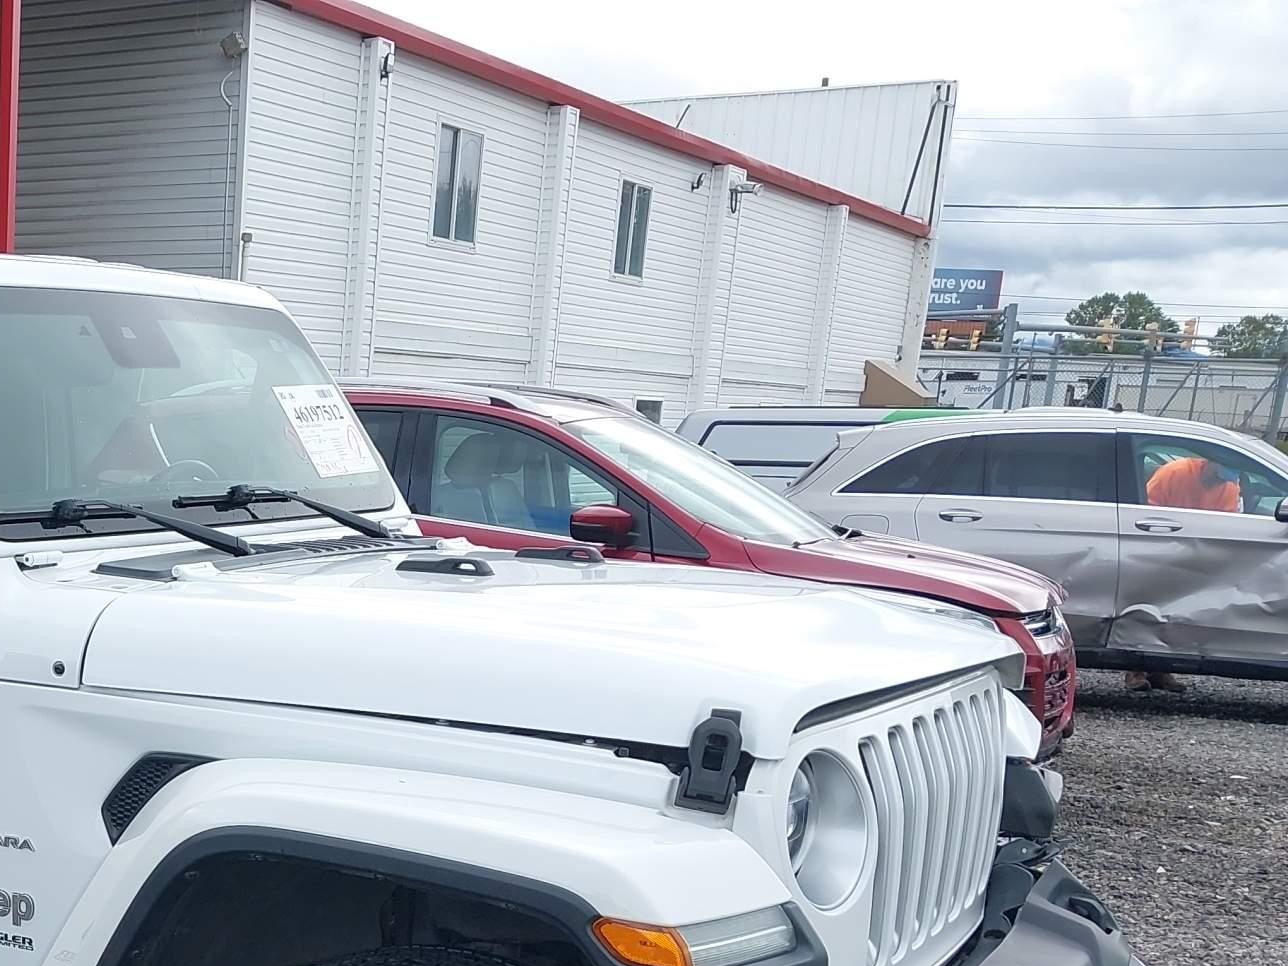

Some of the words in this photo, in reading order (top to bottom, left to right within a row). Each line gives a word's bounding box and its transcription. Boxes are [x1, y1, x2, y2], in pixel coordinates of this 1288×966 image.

[958, 279, 986, 292] you
[929, 293, 961, 304] rust.
[294, 404, 344, 423] 46197512
